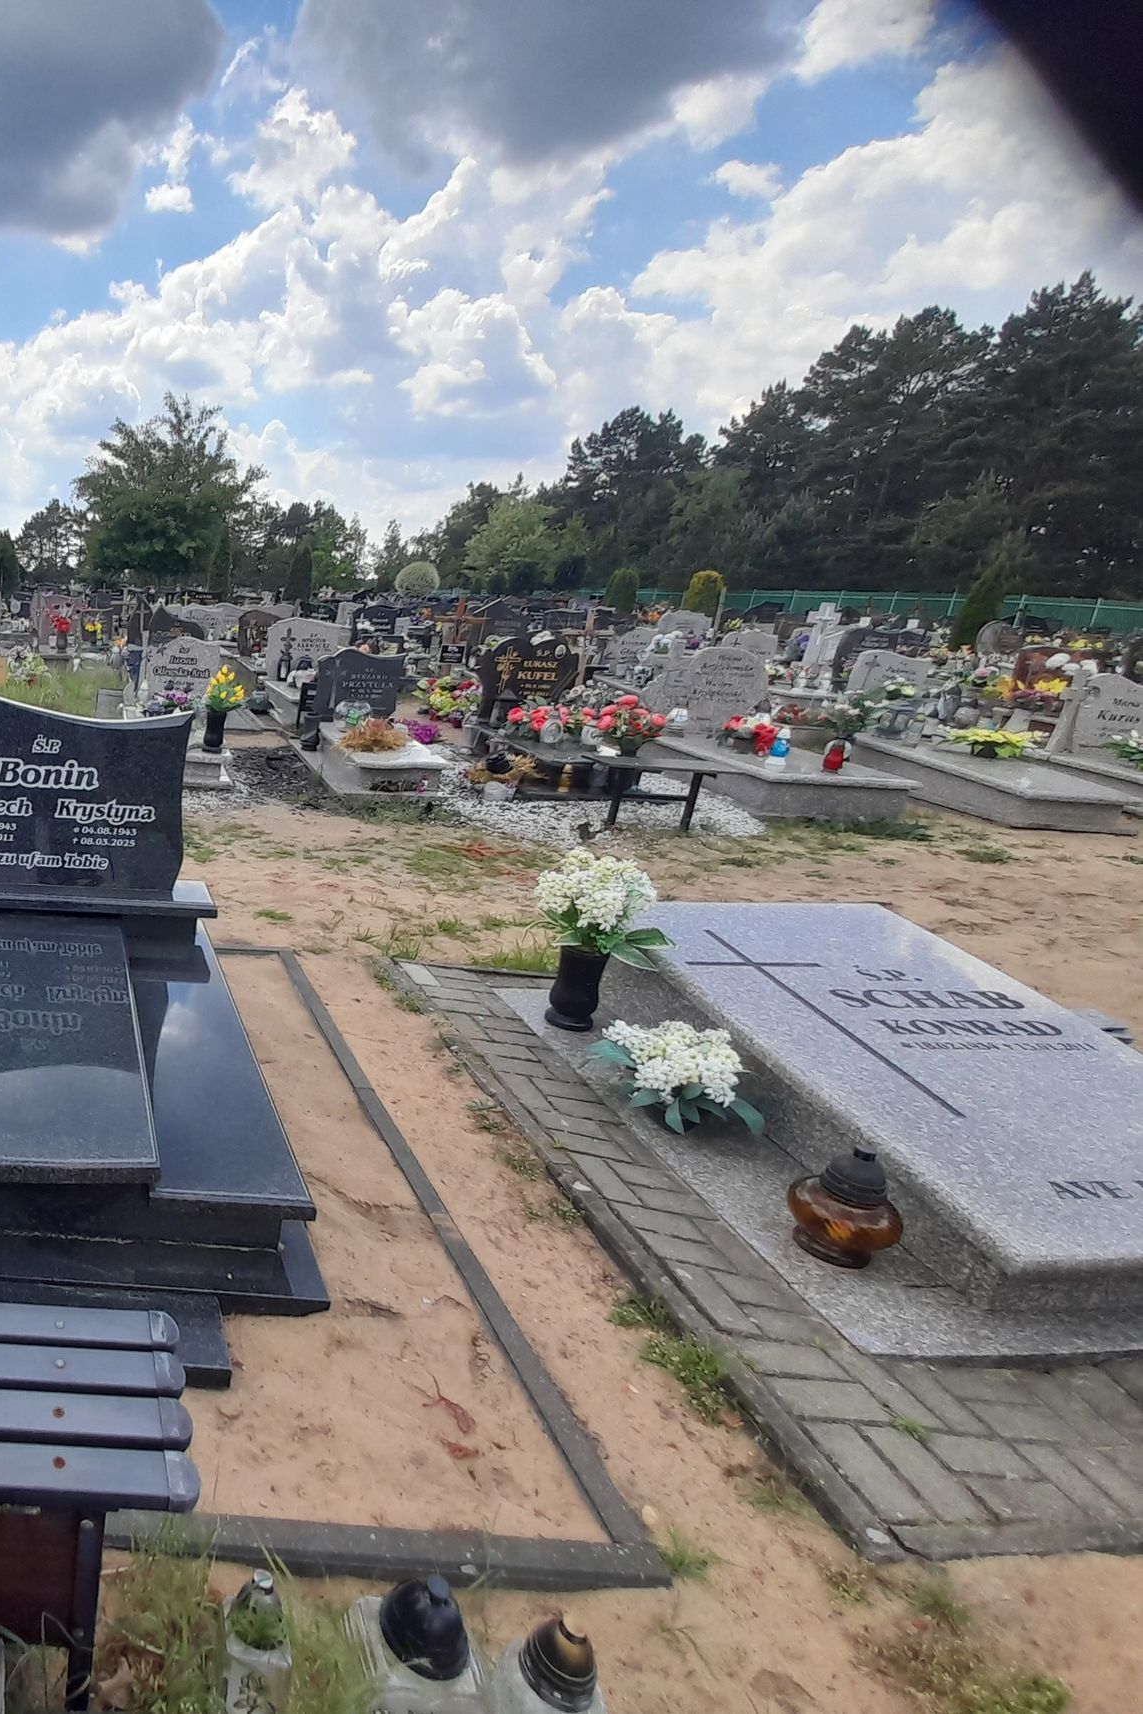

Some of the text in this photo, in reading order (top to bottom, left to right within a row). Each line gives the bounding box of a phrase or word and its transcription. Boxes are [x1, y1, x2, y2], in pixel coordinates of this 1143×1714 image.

[523, 660, 559, 669] ŁUKASZ
[517, 671, 558, 681] KUFEL
[54, 798, 156, 826] Krystyna
[81, 826, 137, 837] 04.08.1943
[80, 837, 136, 848] 08.03.2025
[18, 851, 62, 869] ufam
[64, 851, 109, 870] Tobie
[828, 988, 1026, 1010] SCHAB
[874, 1018, 1063, 1037] KONRAD
[1047, 1180, 1134, 1200] AVE
